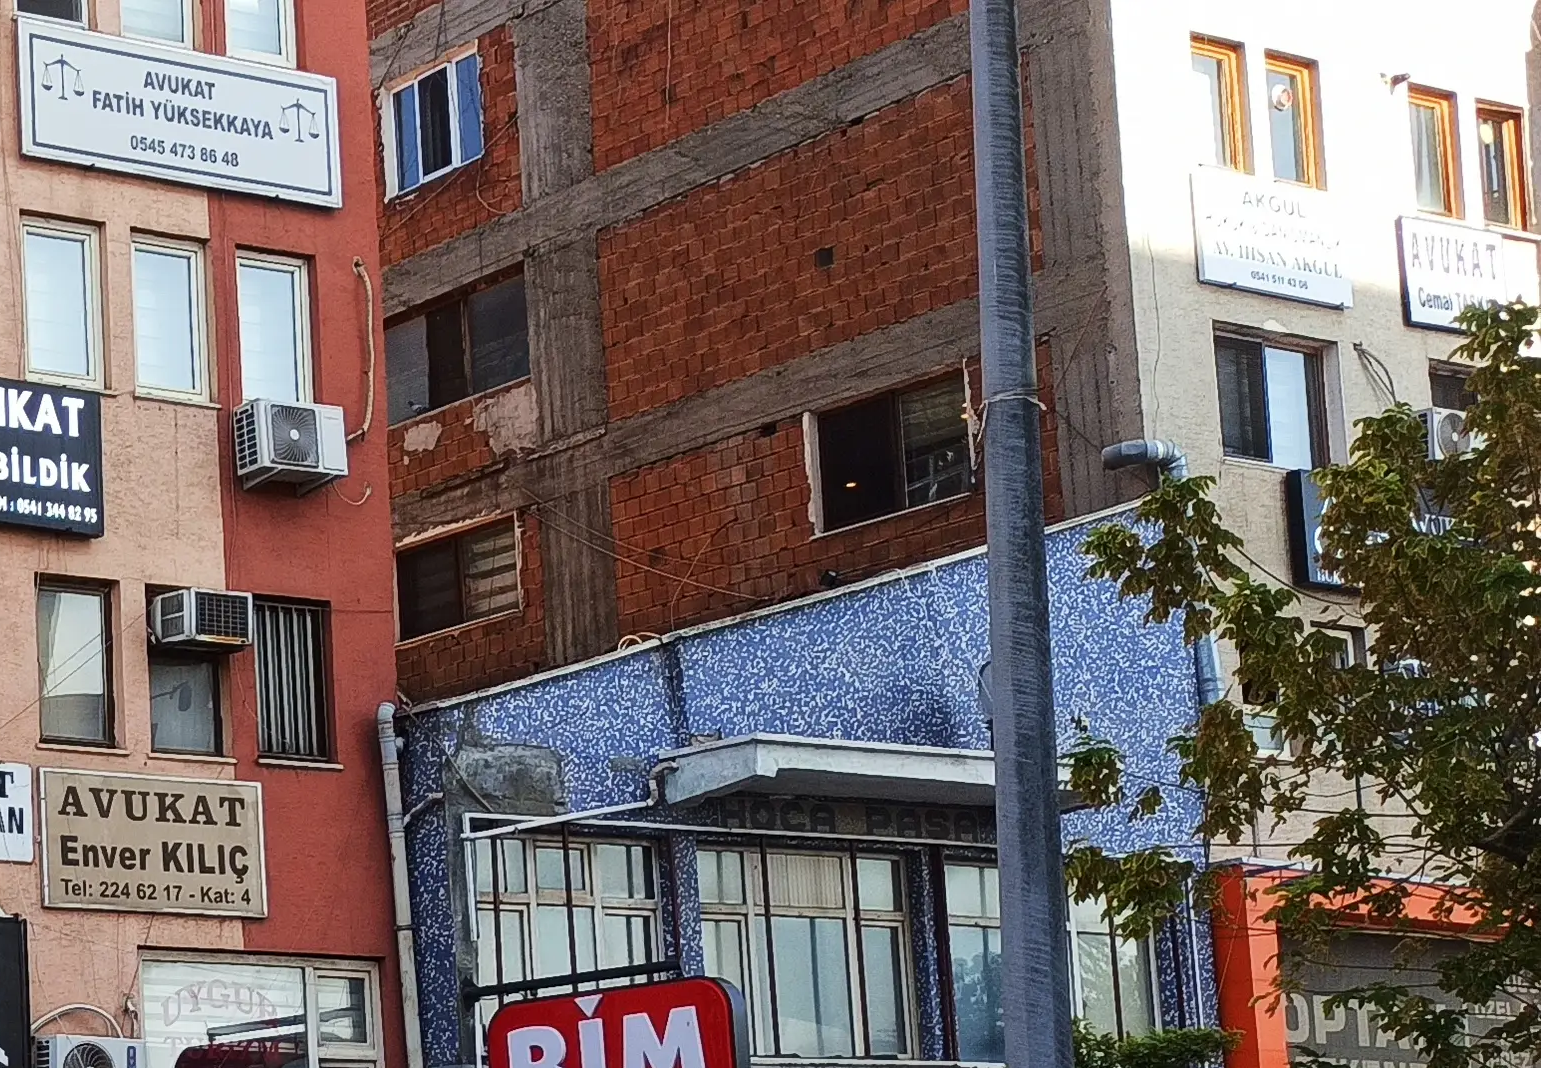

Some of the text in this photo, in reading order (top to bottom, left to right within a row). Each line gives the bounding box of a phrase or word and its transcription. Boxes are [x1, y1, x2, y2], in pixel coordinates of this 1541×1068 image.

[144, 70, 215, 100] AVUKAT
[92, 89, 274, 141] FATİH YÜKSEKKAYA
[131, 135, 239, 167] 0545 473 86 48
[1412, 232, 1496, 280] AVUKAT
[1418, 287, 1453, 310] Cemal
[58, 786, 245, 828] AVUKAT
[60, 835, 249, 885] Enver KILIÇ
[61, 878, 235, 905] Tel: 224 62 17 Kat:
